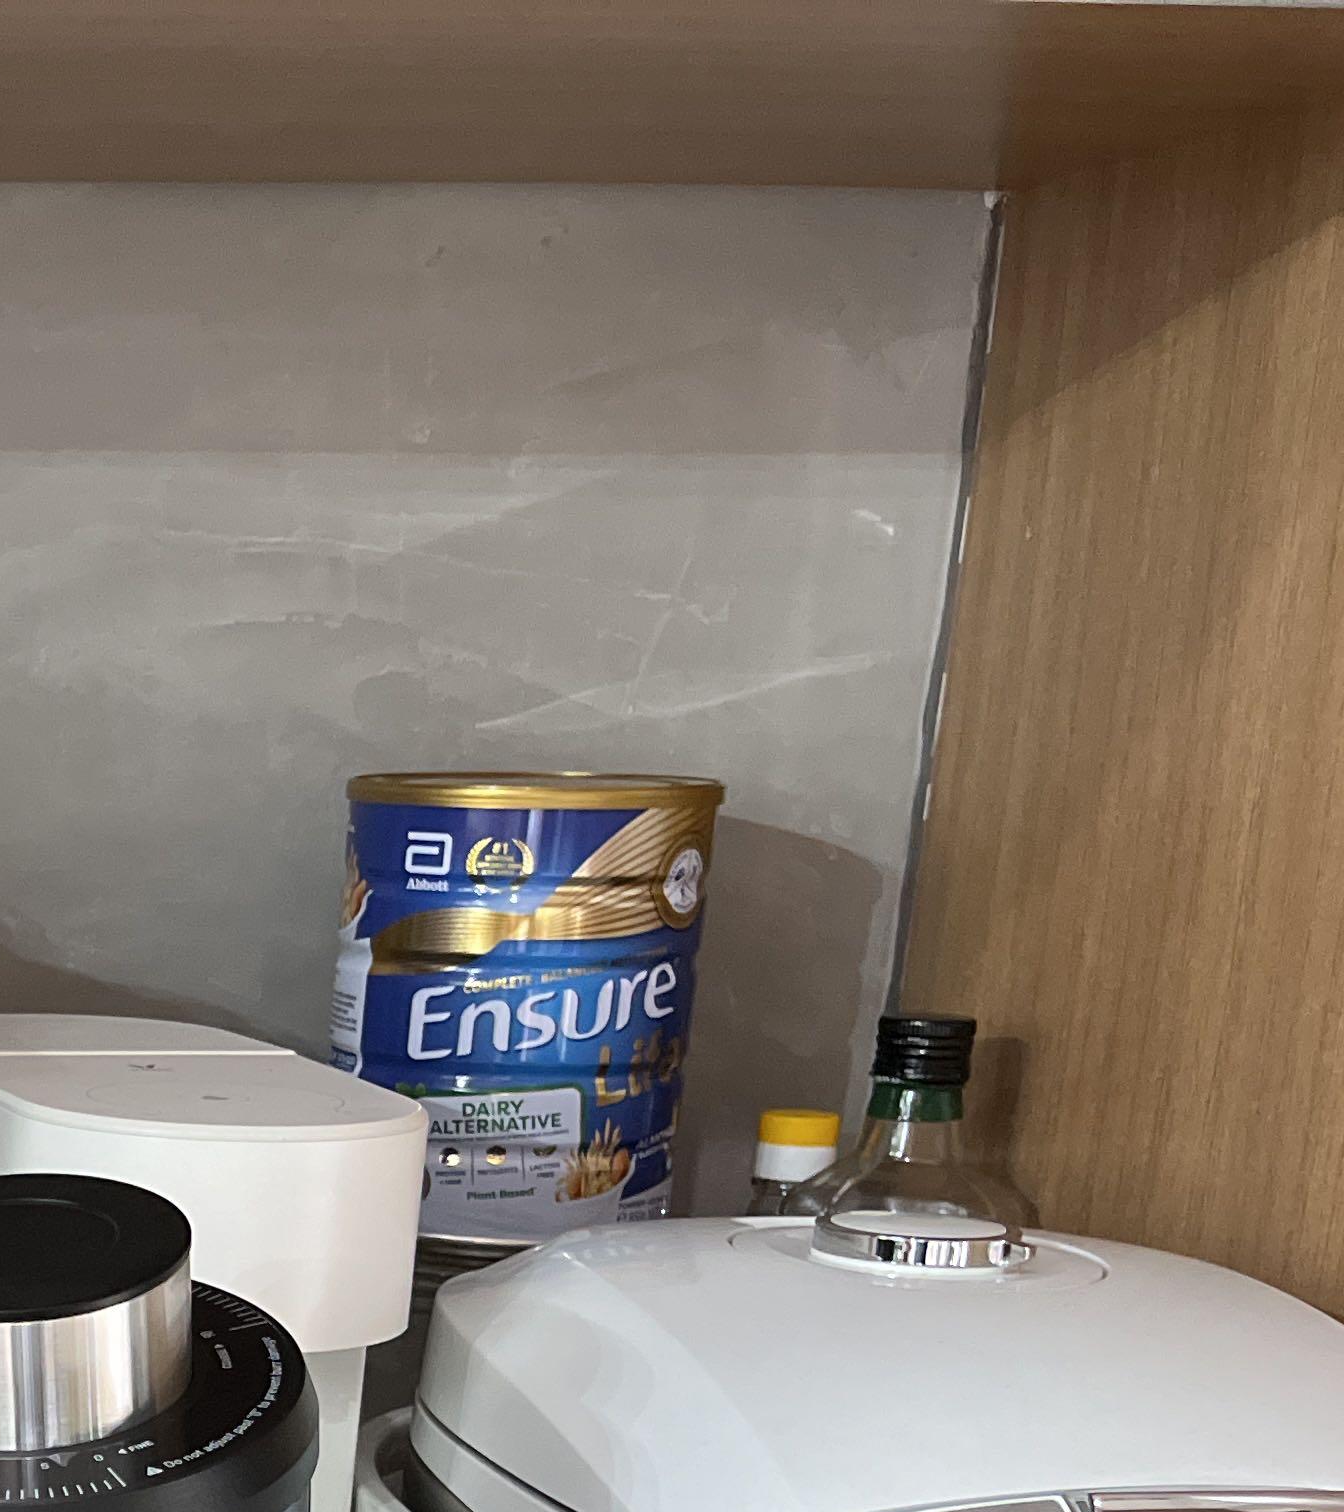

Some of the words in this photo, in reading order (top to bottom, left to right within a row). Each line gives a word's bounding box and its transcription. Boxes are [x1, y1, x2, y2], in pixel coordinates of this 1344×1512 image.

[406, 877, 450, 892] Abbott
[407, 961, 677, 1061] Ensure
[462, 1100, 524, 1117] DAIRY
[429, 1112, 562, 1135] ALTERNATIVE
[163, 1458, 183, 1469] Do
[183, 1449, 205, 1462] not
